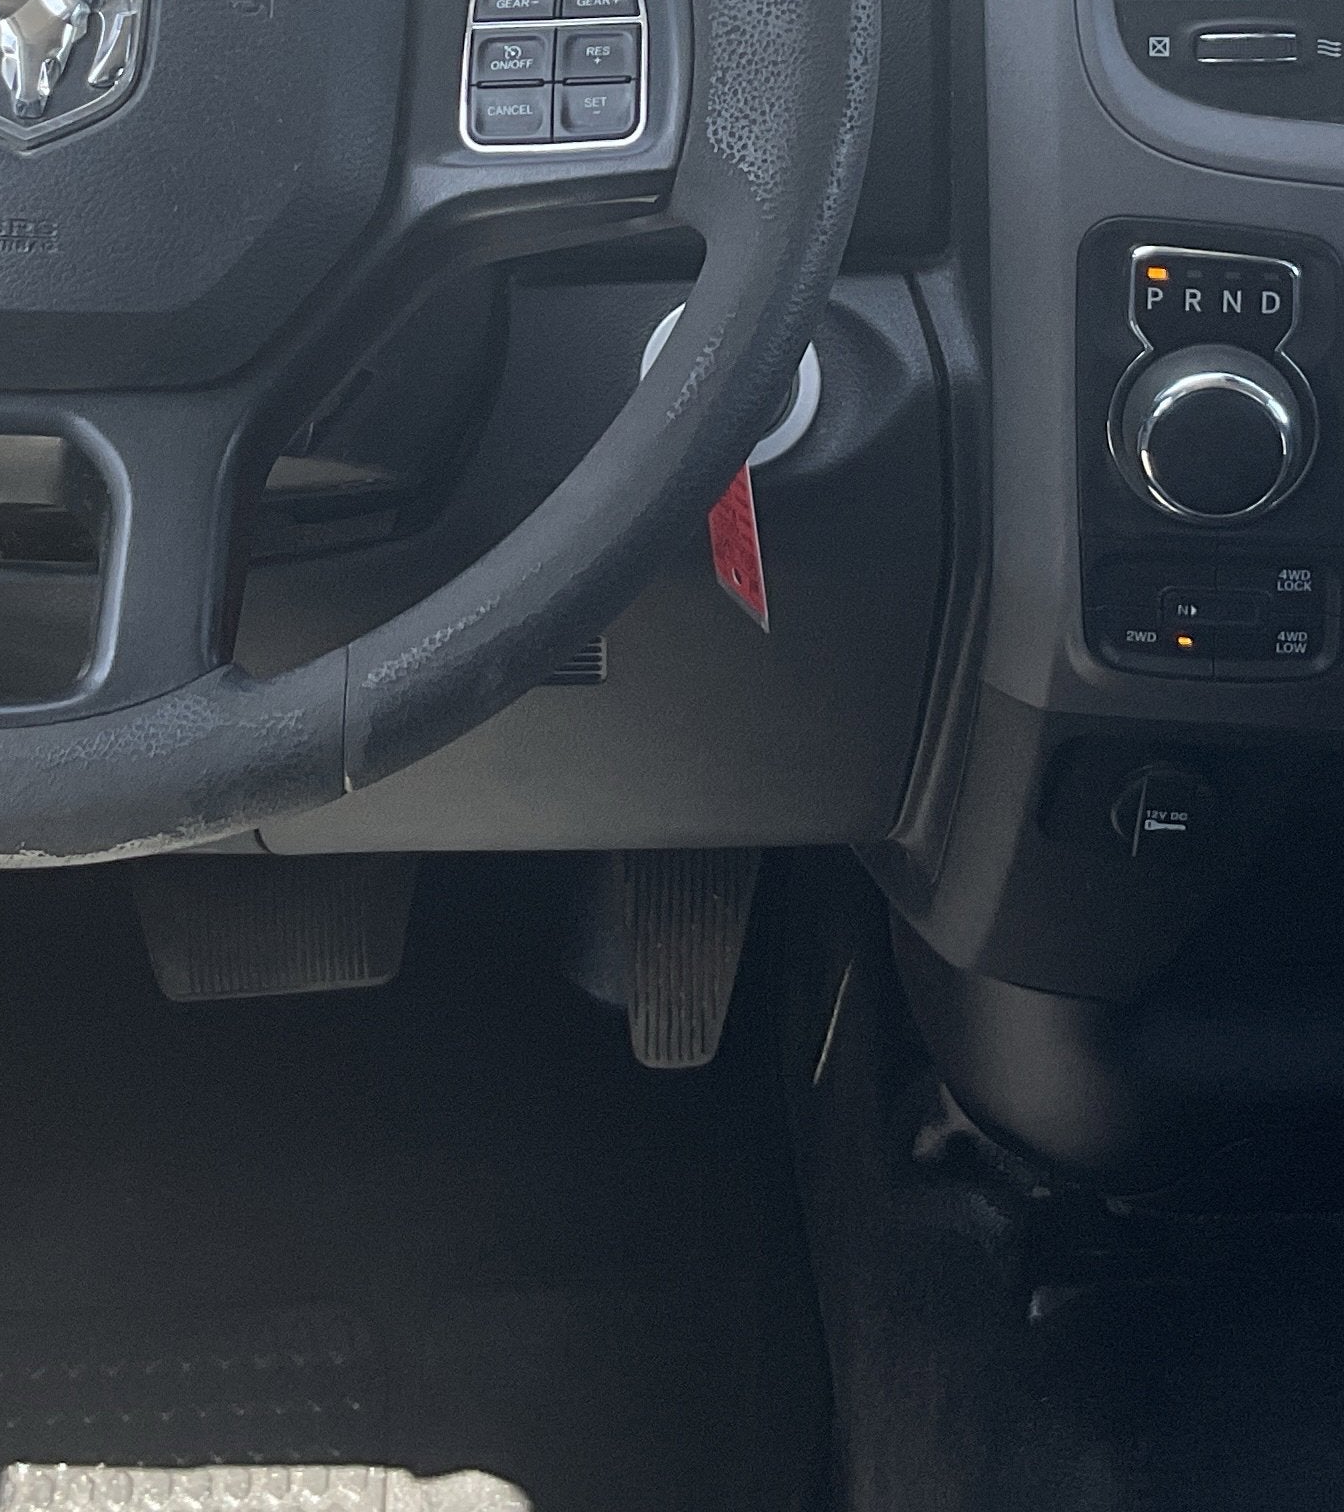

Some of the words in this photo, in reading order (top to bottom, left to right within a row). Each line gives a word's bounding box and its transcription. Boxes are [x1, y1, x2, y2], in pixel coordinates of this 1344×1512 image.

[586, 46, 610, 57] RES
[490, 59, 533, 70] ON/OFF
[584, 97, 607, 108] SET
[487, 104, 533, 116] CANCEL
[1278, 569, 1311, 581] 4WD
[1277, 580, 1312, 592] LOCK
[1126, 630, 1157, 643] 2WD
[1277, 631, 1308, 643] 4WD
[1276, 642, 1307, 654] LOW
[1145, 809, 1167, 821] 12V
[1170, 811, 1189, 822] DC
